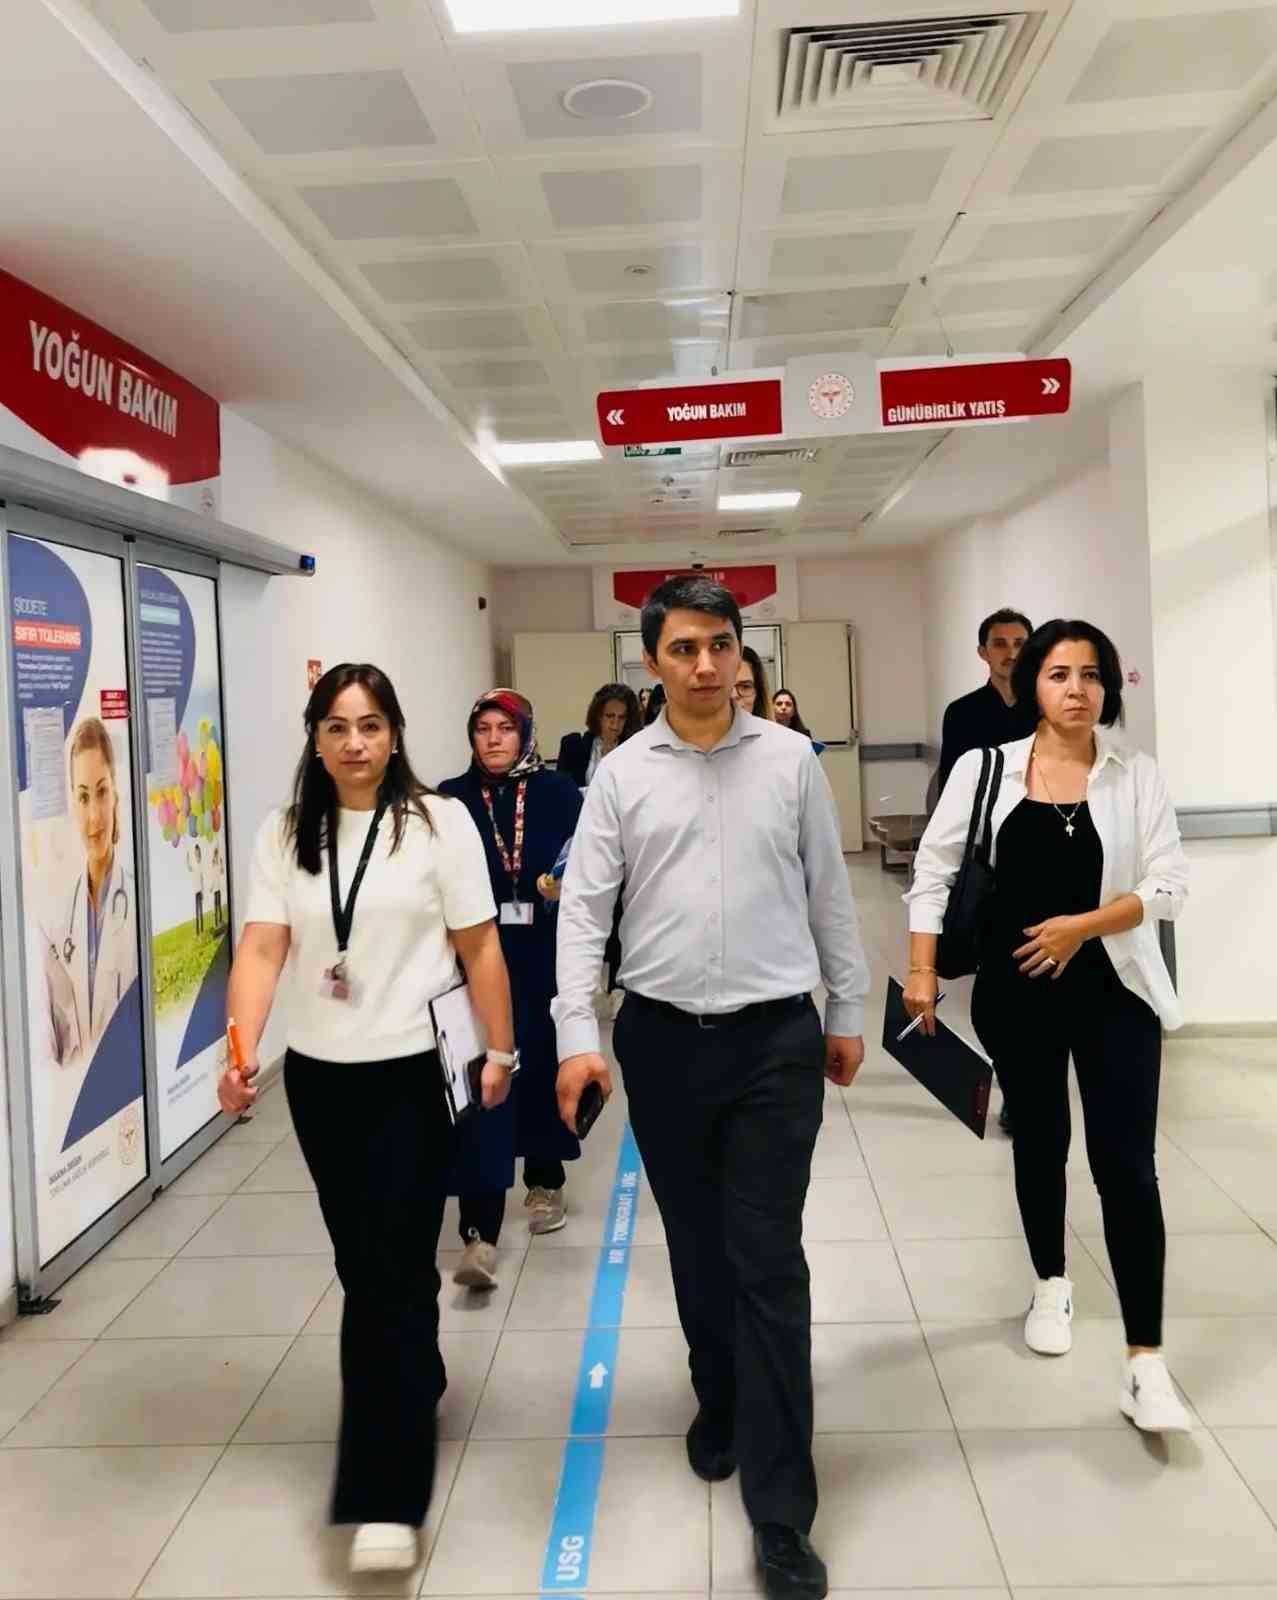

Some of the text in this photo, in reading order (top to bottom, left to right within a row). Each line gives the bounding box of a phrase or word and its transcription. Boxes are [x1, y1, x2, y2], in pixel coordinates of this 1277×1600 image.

[29, 319, 178, 438] YOĞUN BAKIM
[666, 402, 746, 421] YOĞUN BAKIM
[887, 400, 1006, 423] GÜNÜBİRLİK YATIŞ
[555, 1535, 585, 1581] USG
